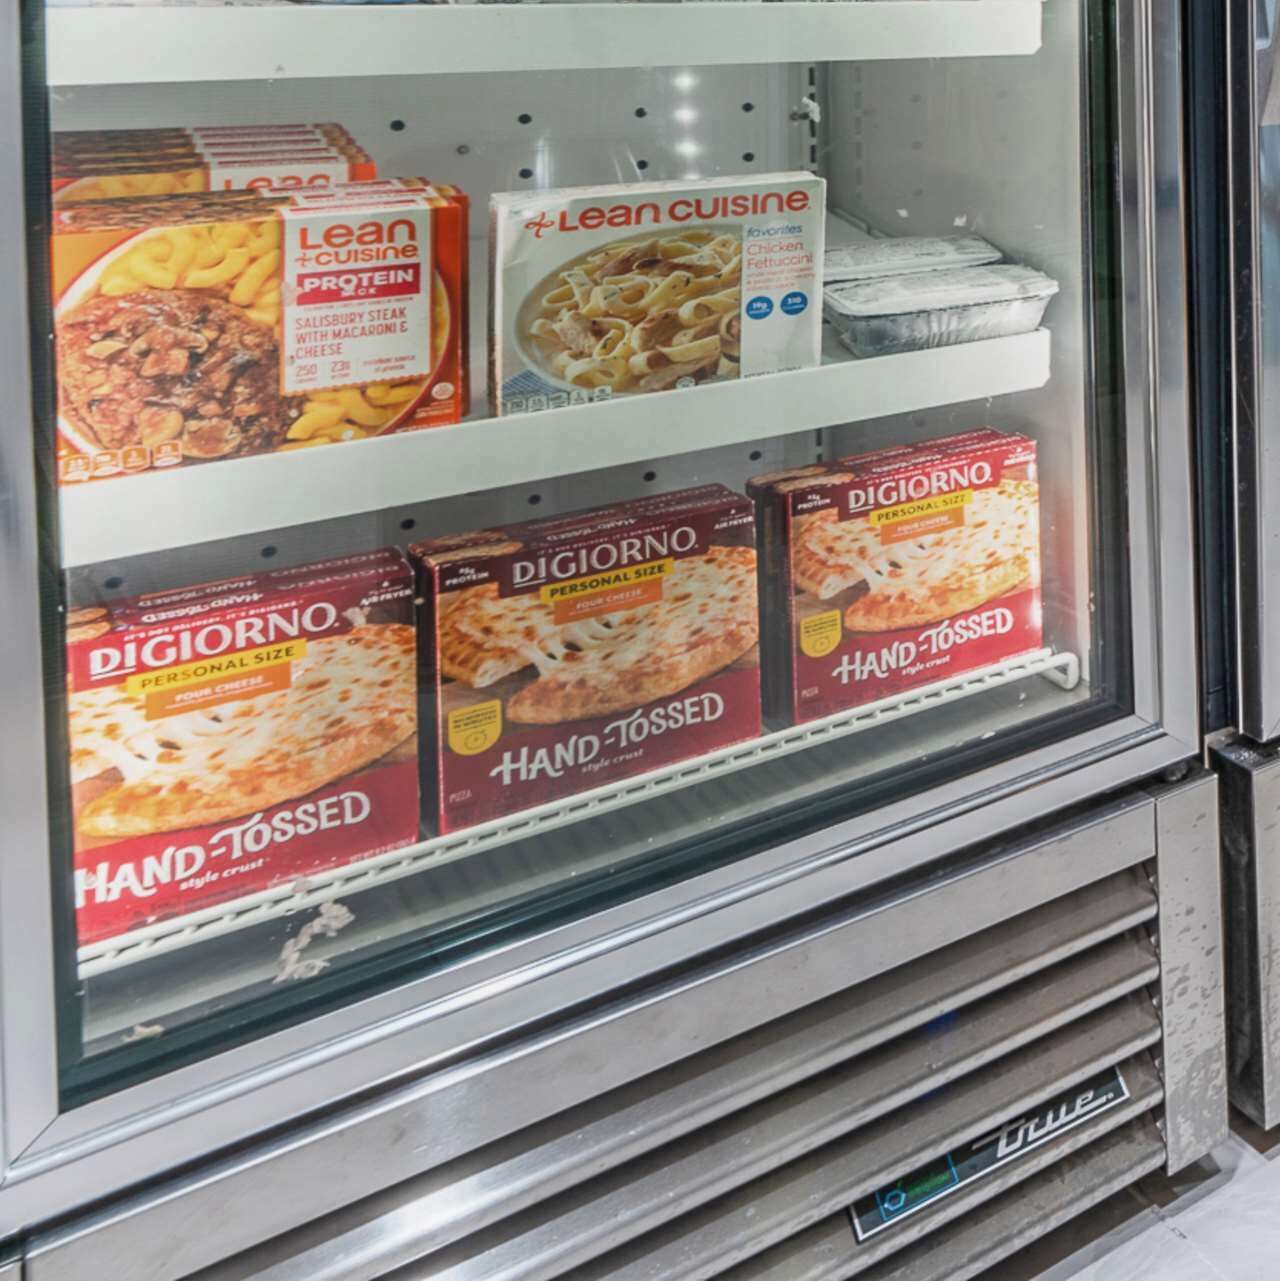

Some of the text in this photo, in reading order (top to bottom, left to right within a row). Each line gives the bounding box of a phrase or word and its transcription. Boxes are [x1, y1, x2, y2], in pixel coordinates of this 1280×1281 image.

[746, 241, 805, 257] Chicken
[303, 268, 414, 293] PROTEIN
[295, 307, 408, 331] SALISBURY STEAK
[295, 331, 330, 345] WITH
[332, 323, 397, 340] MACARONI
[295, 343, 343, 360] CHEESE
[876, 503, 940, 522] PERSONAL
[445, 571, 489, 587] PROTEIN
[549, 563, 666, 600] PERSONAL SIZE
[575, 588, 643, 611] FOUR CHEESE
[831, 607, 1015, 685] HAND-TOSSED
[141, 646, 296, 690] PERSONAL SIZE
[174, 675, 264, 703] FOUR CHEESE
[489, 692, 725, 785] HAND-TOSSED
[581, 747, 645, 774] style crust
[75, 790, 371, 909] HAND-TOSSED
[178, 857, 267, 892] style crust
